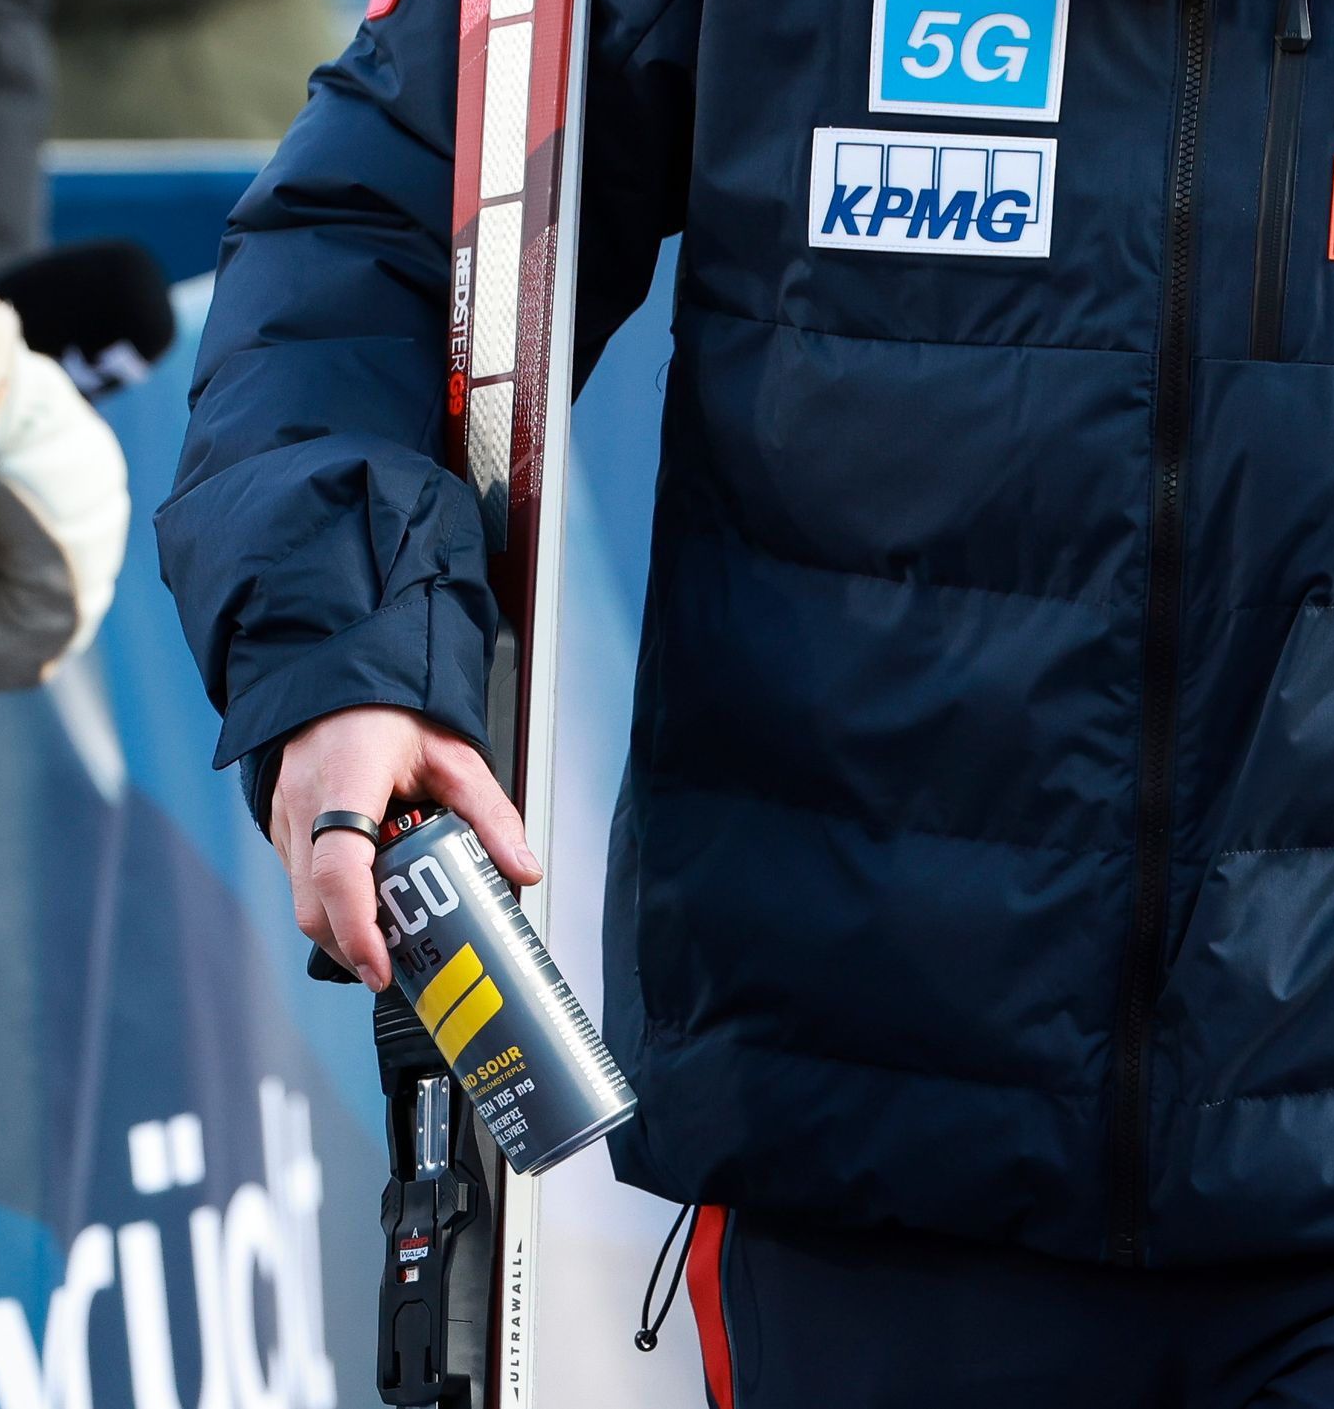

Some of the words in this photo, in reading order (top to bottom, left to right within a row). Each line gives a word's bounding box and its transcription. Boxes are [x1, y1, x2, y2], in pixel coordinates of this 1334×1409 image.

[901, 10, 1031, 83] 5G
[821, 185, 1031, 242] KPMG
[451, 247, 472, 372] REDSTER
[477, 1046, 523, 1080] SOUR
[494, 1089, 515, 1109] 105
[515, 1077, 535, 1096] mg
[401, 1247, 427, 1258] WALK
[510, 1257, 522, 1382] ULTRAWALL
